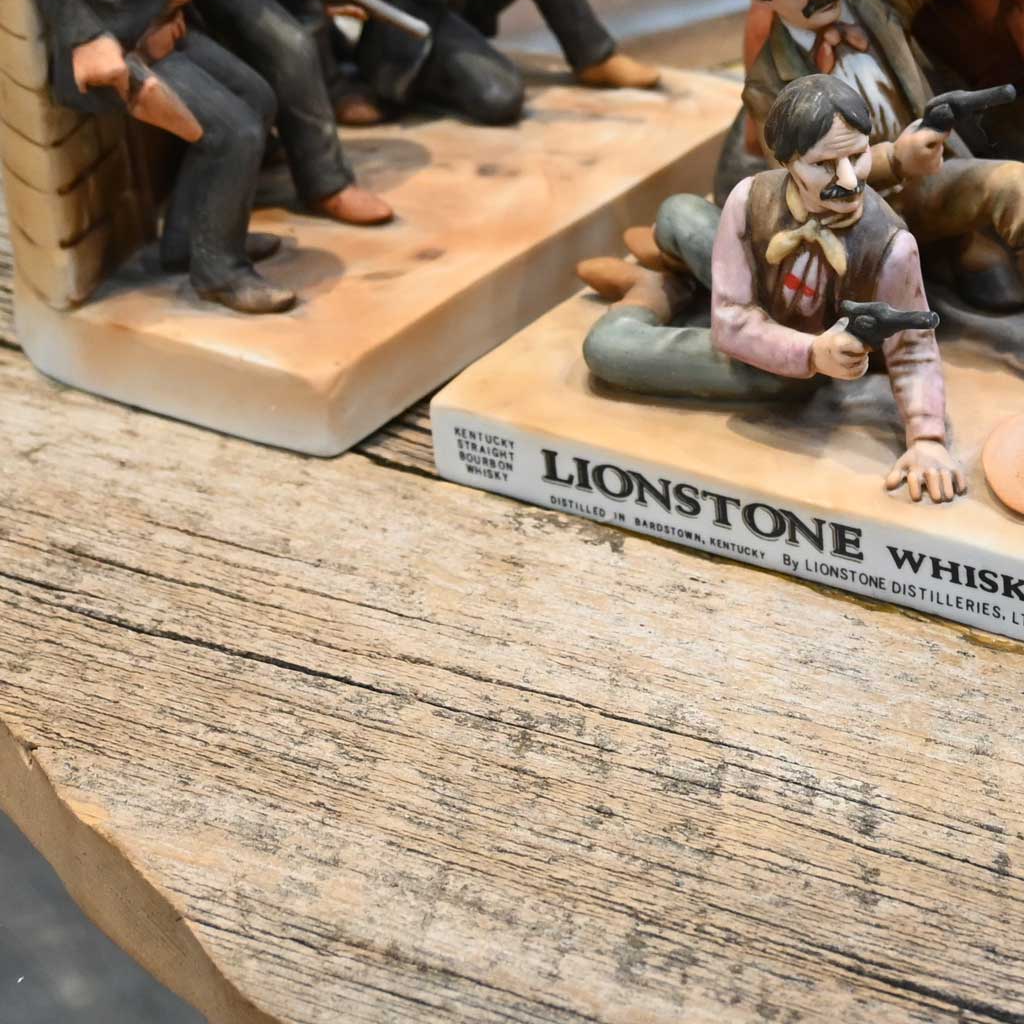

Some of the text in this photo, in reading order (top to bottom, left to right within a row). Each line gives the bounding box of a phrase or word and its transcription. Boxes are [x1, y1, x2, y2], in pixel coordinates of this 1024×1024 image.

[454, 427, 515, 448] KENTUCKY
[457, 439, 515, 460] STRAIGHT
[459, 451, 513, 471] BOURBON
[466, 464, 508, 482] WHISKY
[541, 449, 863, 563] LIONSTONE
[550, 495, 606, 518] DISTILLED
[613, 511, 626, 523] IN
[710, 537, 766, 560] KENTUCKY
[782, 553, 799, 572] By
[806, 561, 887, 591] LIONSTONE
